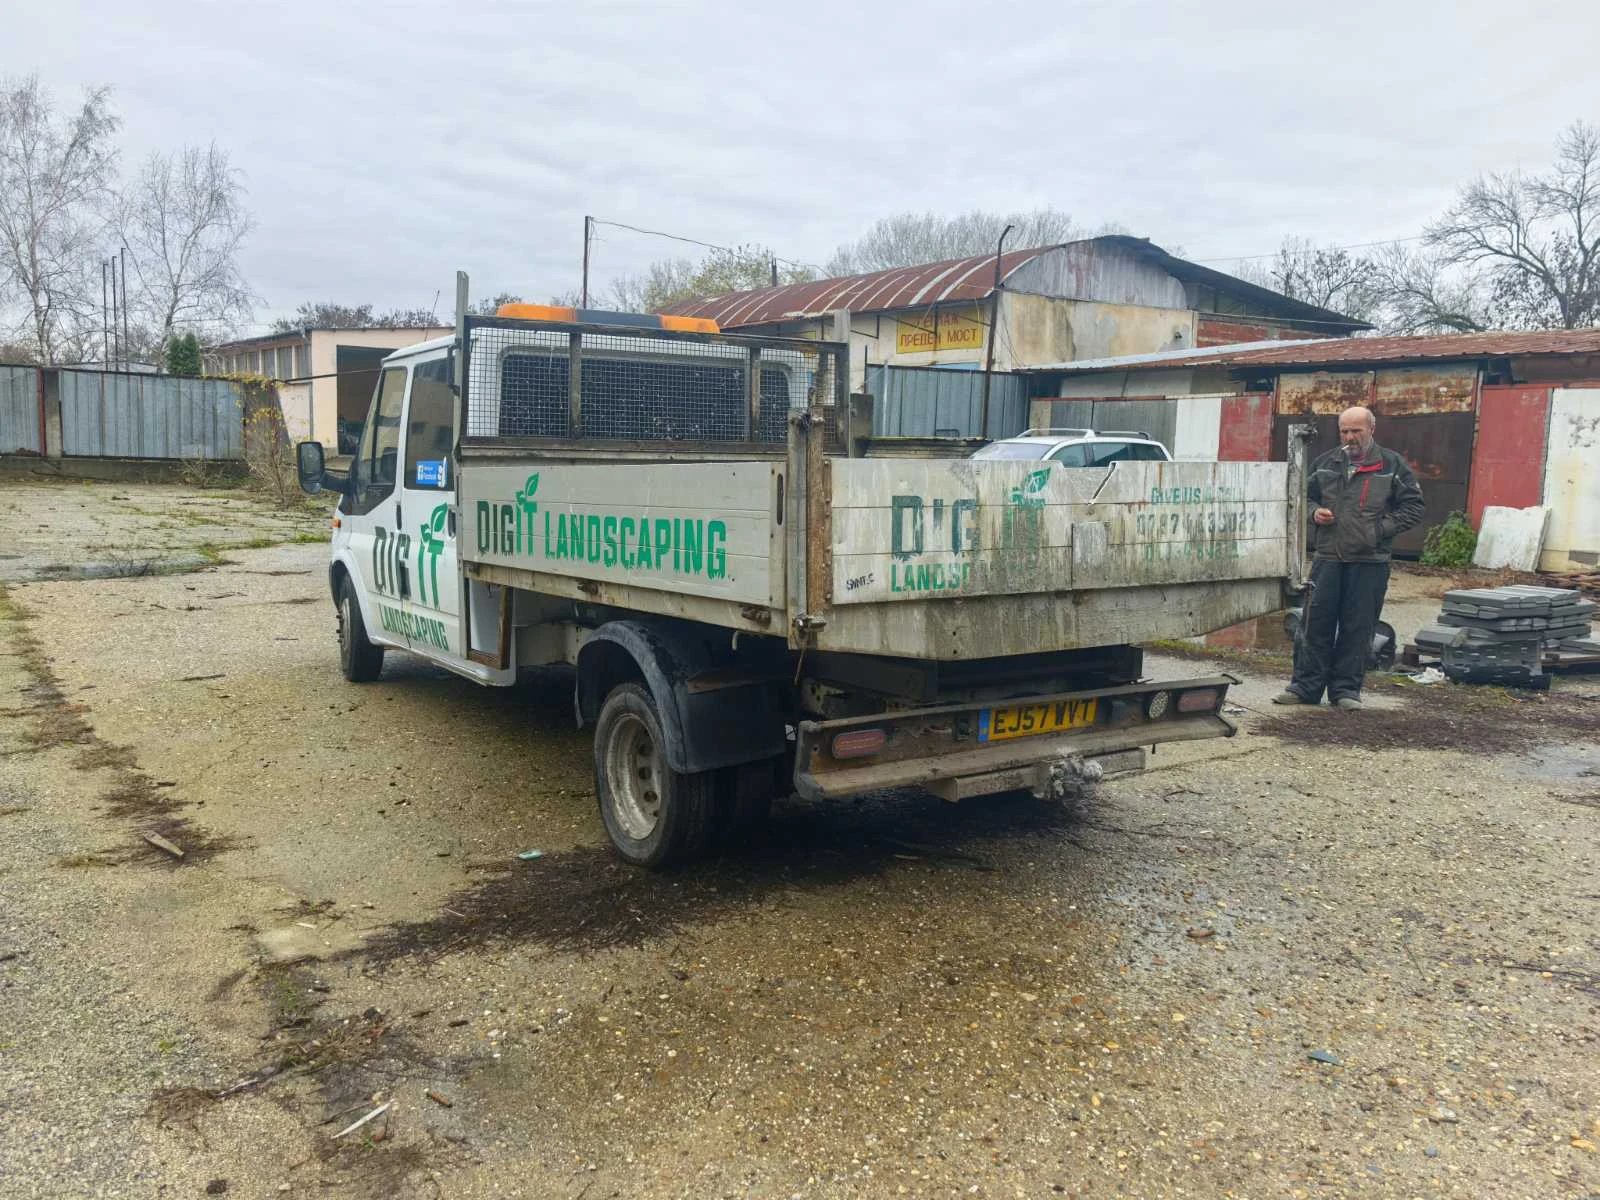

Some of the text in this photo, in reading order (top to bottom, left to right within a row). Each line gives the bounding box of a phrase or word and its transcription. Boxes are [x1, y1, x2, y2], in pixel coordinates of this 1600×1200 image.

[947, 328, 978, 343] МОСТ
[1184, 487, 1201, 504] US
[545, 510, 728, 581] LANDSCAPING
[379, 602, 449, 650] LANDSCAPING
[993, 703, 1050, 734] EJ57
